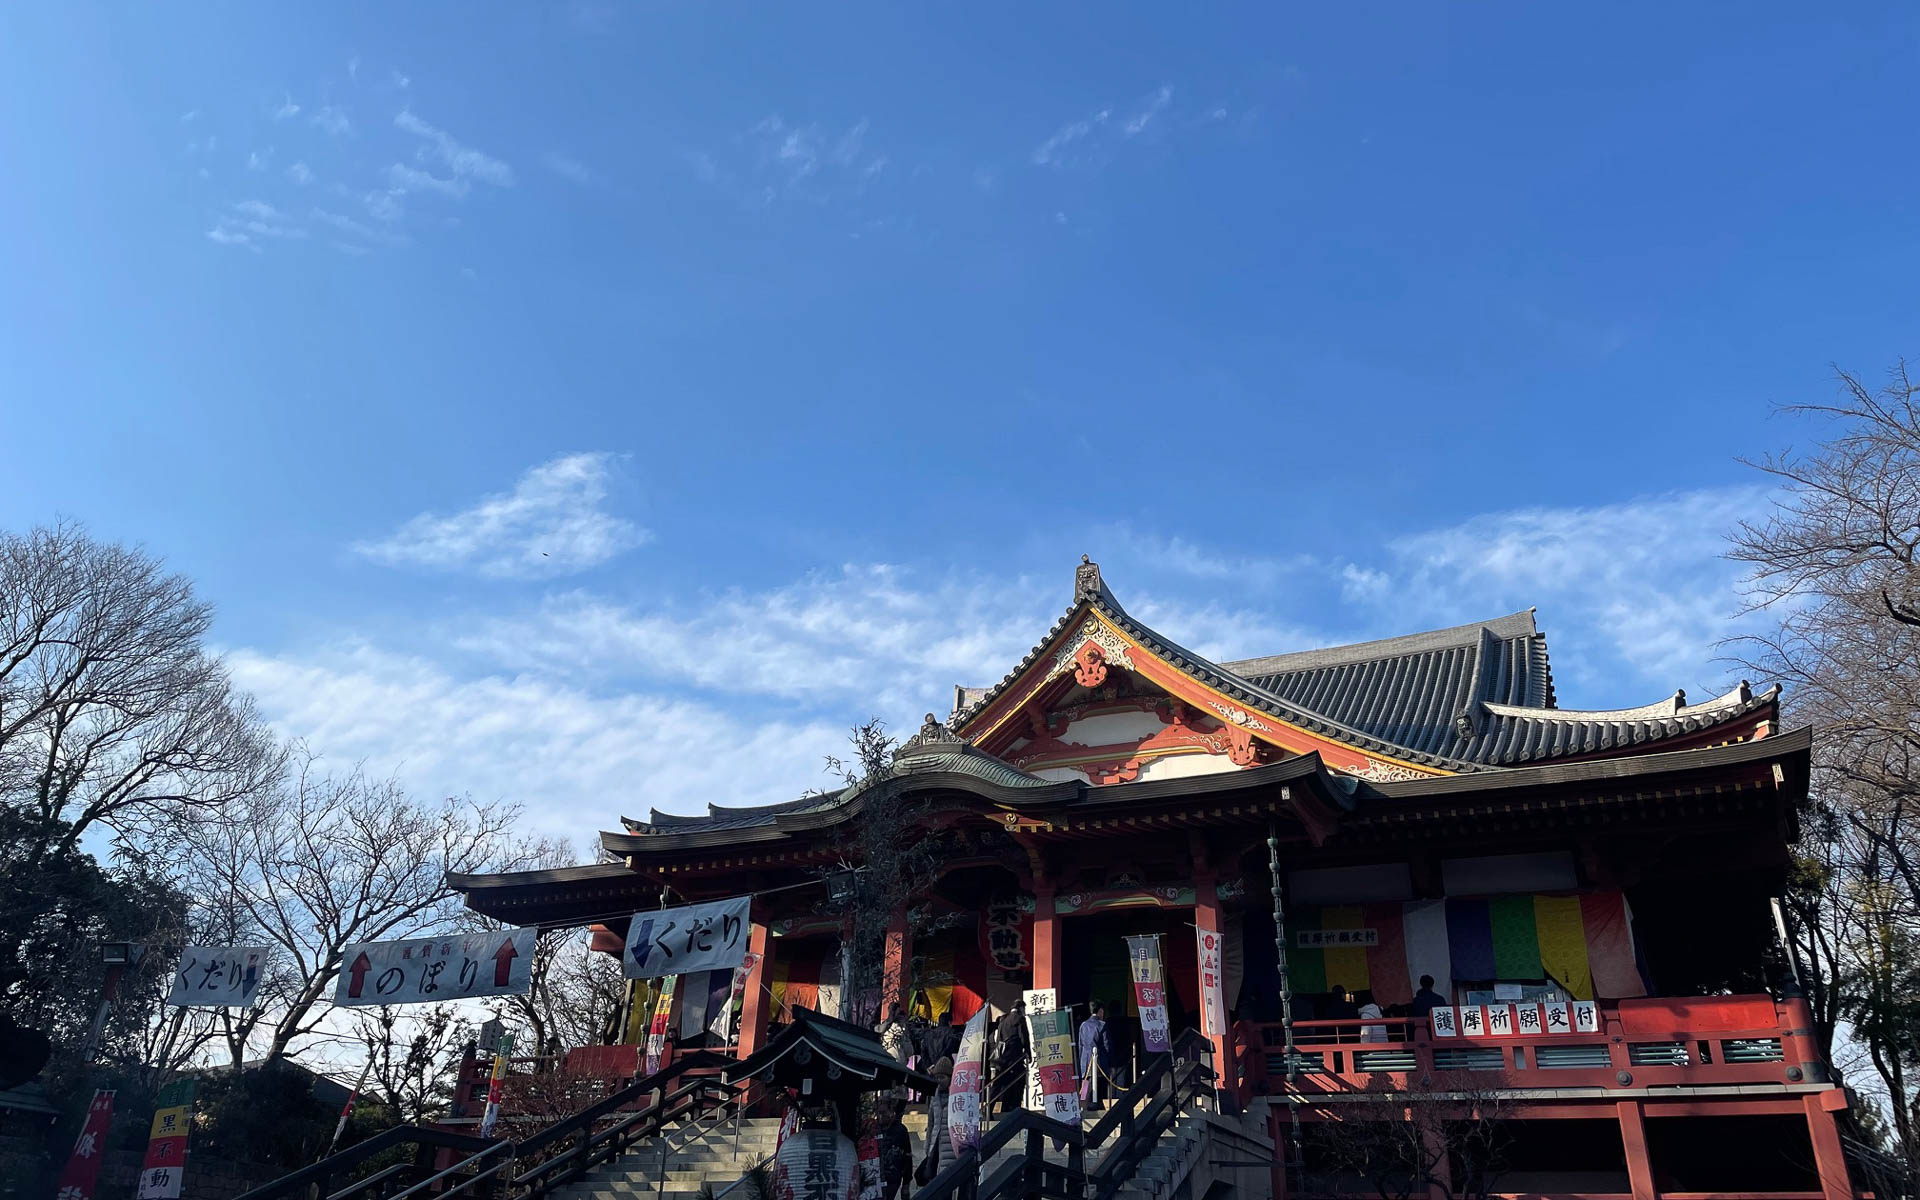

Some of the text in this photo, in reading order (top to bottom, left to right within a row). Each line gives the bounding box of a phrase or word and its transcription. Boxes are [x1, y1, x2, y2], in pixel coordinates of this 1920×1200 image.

[656, 914, 741, 958] くだり
[181, 958, 242, 992] くだり
[376, 957, 478, 995] のぼり
[1435, 1006, 1593, 1031] 護摩祈願受付
[150, 1090, 179, 1199] 目黒不動
